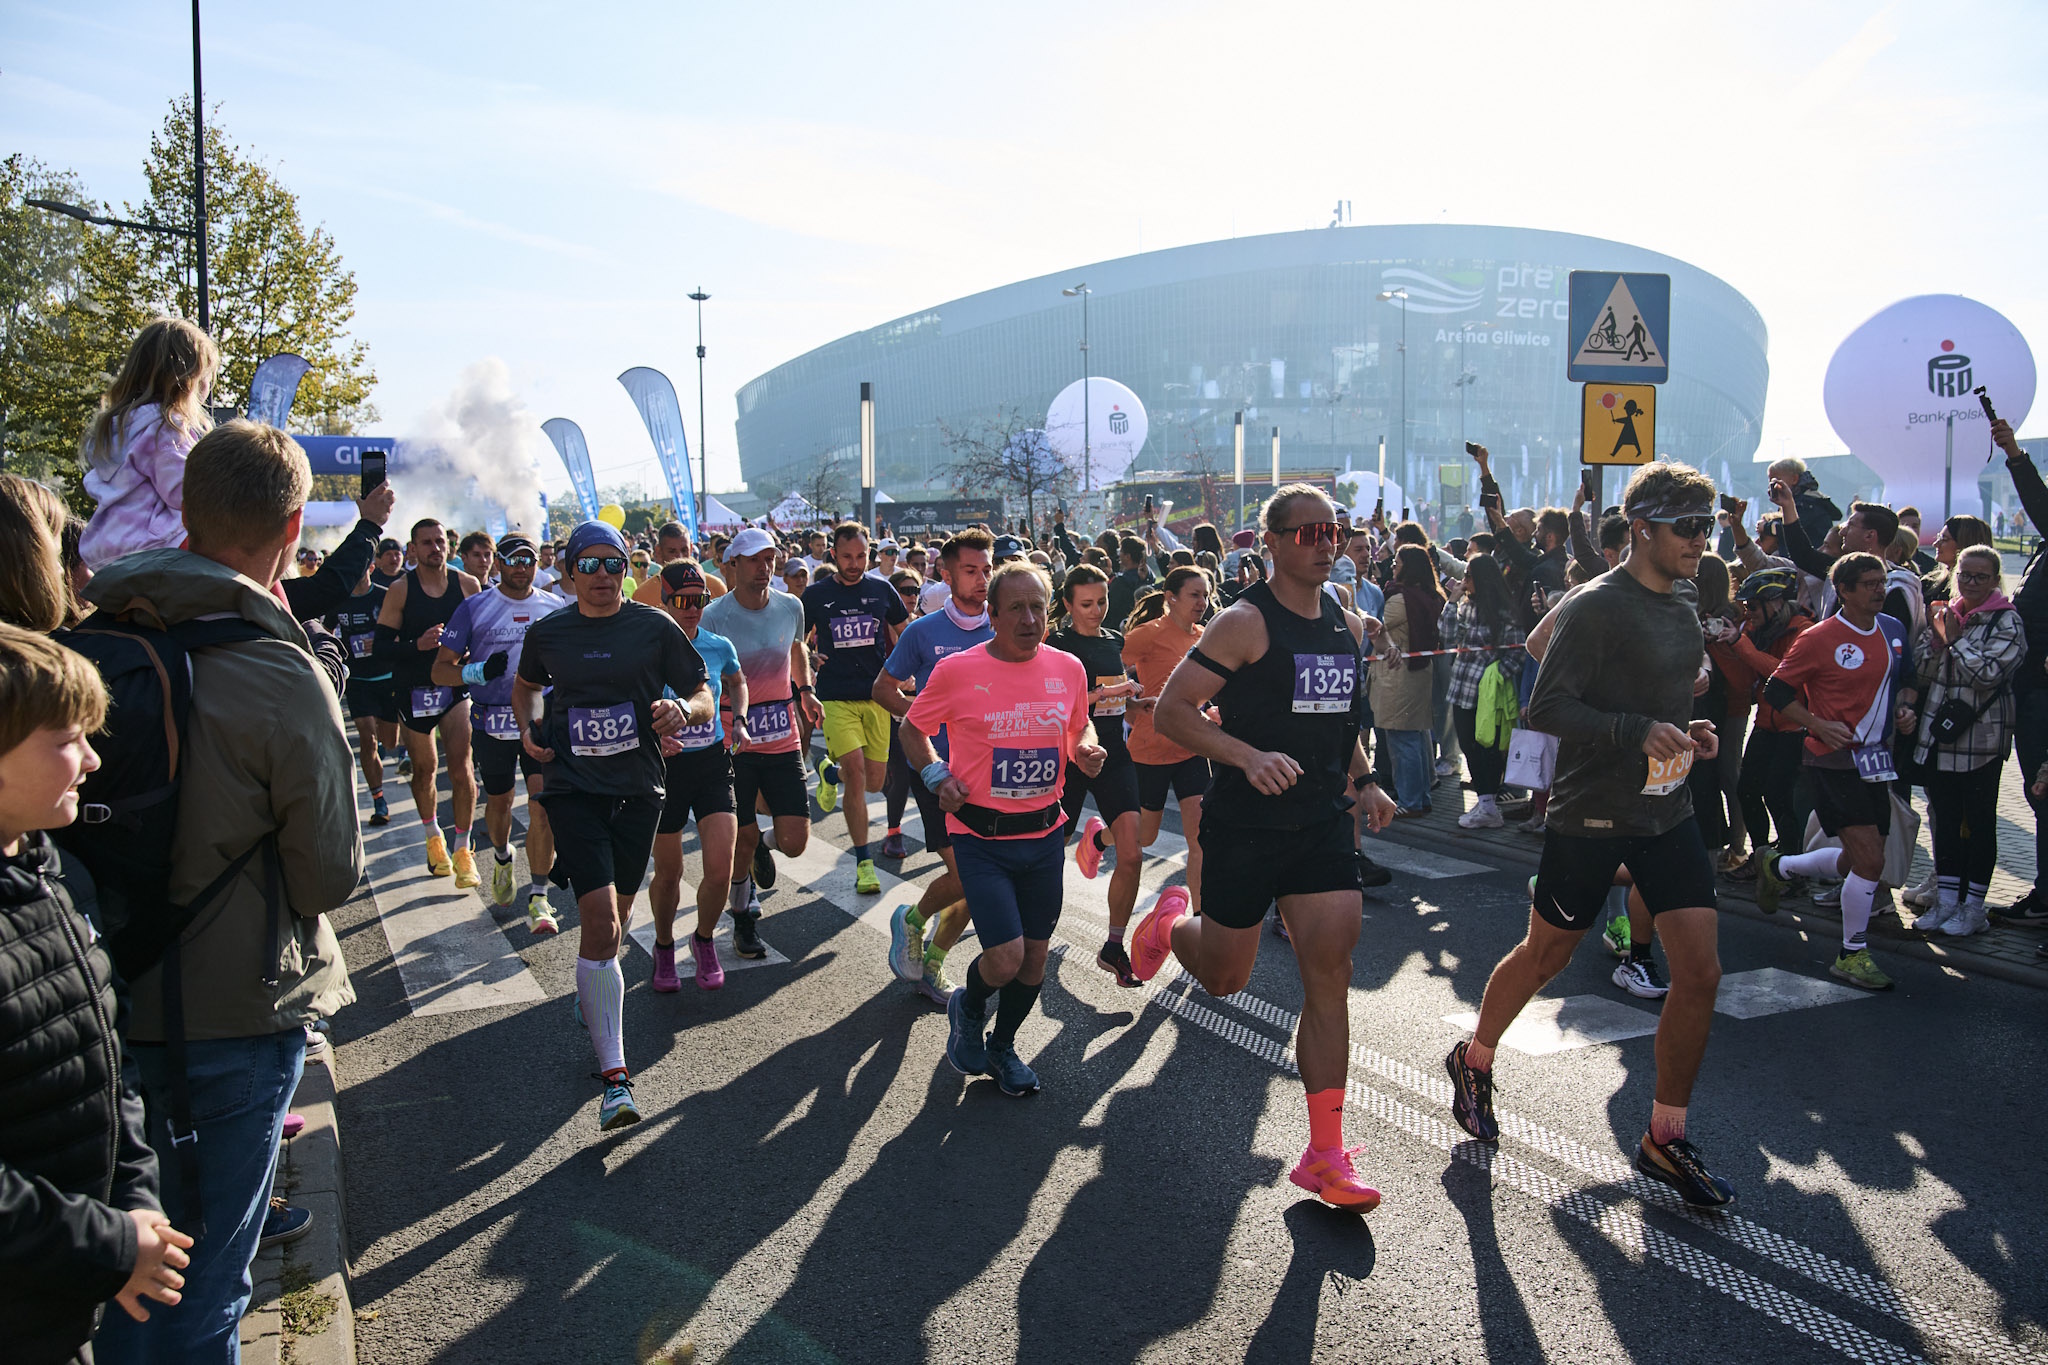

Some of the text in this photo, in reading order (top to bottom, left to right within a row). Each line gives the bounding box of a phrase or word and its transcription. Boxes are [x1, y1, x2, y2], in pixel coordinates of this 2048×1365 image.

[1435, 328, 1550, 346] Arena Gliwice
[1928, 354, 1972, 398] PKO
[1908, 411, 1945, 424] Bank
[834, 622, 872, 639] 1817
[1300, 668, 1354, 695] 1325
[423, 691, 442, 707] 57
[488, 713, 519, 730] 175
[748, 711, 788, 733] 1418
[984, 711, 1023, 722] MARATHON
[1014, 718, 1030, 731] KM
[573, 714, 634, 742] 1382
[997, 759, 1056, 783] 1328
